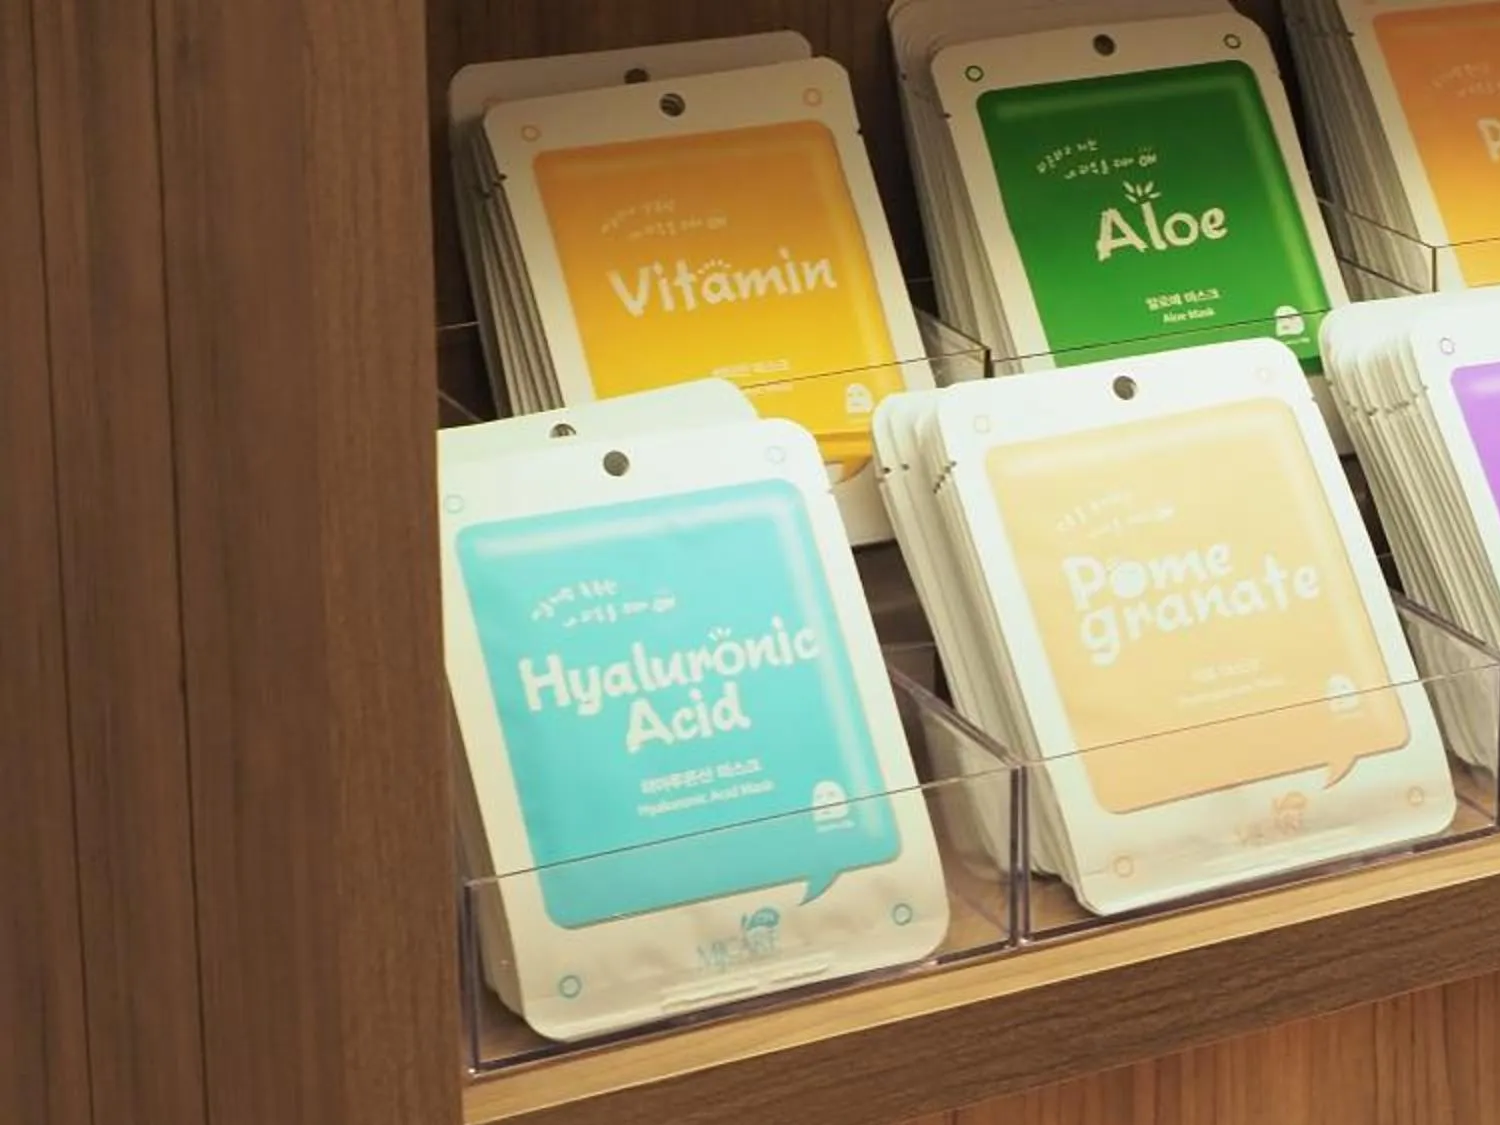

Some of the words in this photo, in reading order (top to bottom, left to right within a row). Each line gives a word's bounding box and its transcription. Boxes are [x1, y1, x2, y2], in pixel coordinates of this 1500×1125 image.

[1095, 200, 1228, 261] Aloe
[606, 247, 838, 318] Vitamin
[1061, 541, 1235, 612] Pome
[1080, 553, 1322, 668] granate
[517, 615, 820, 717] Hyaluronic
[624, 682, 752, 752] Acid
